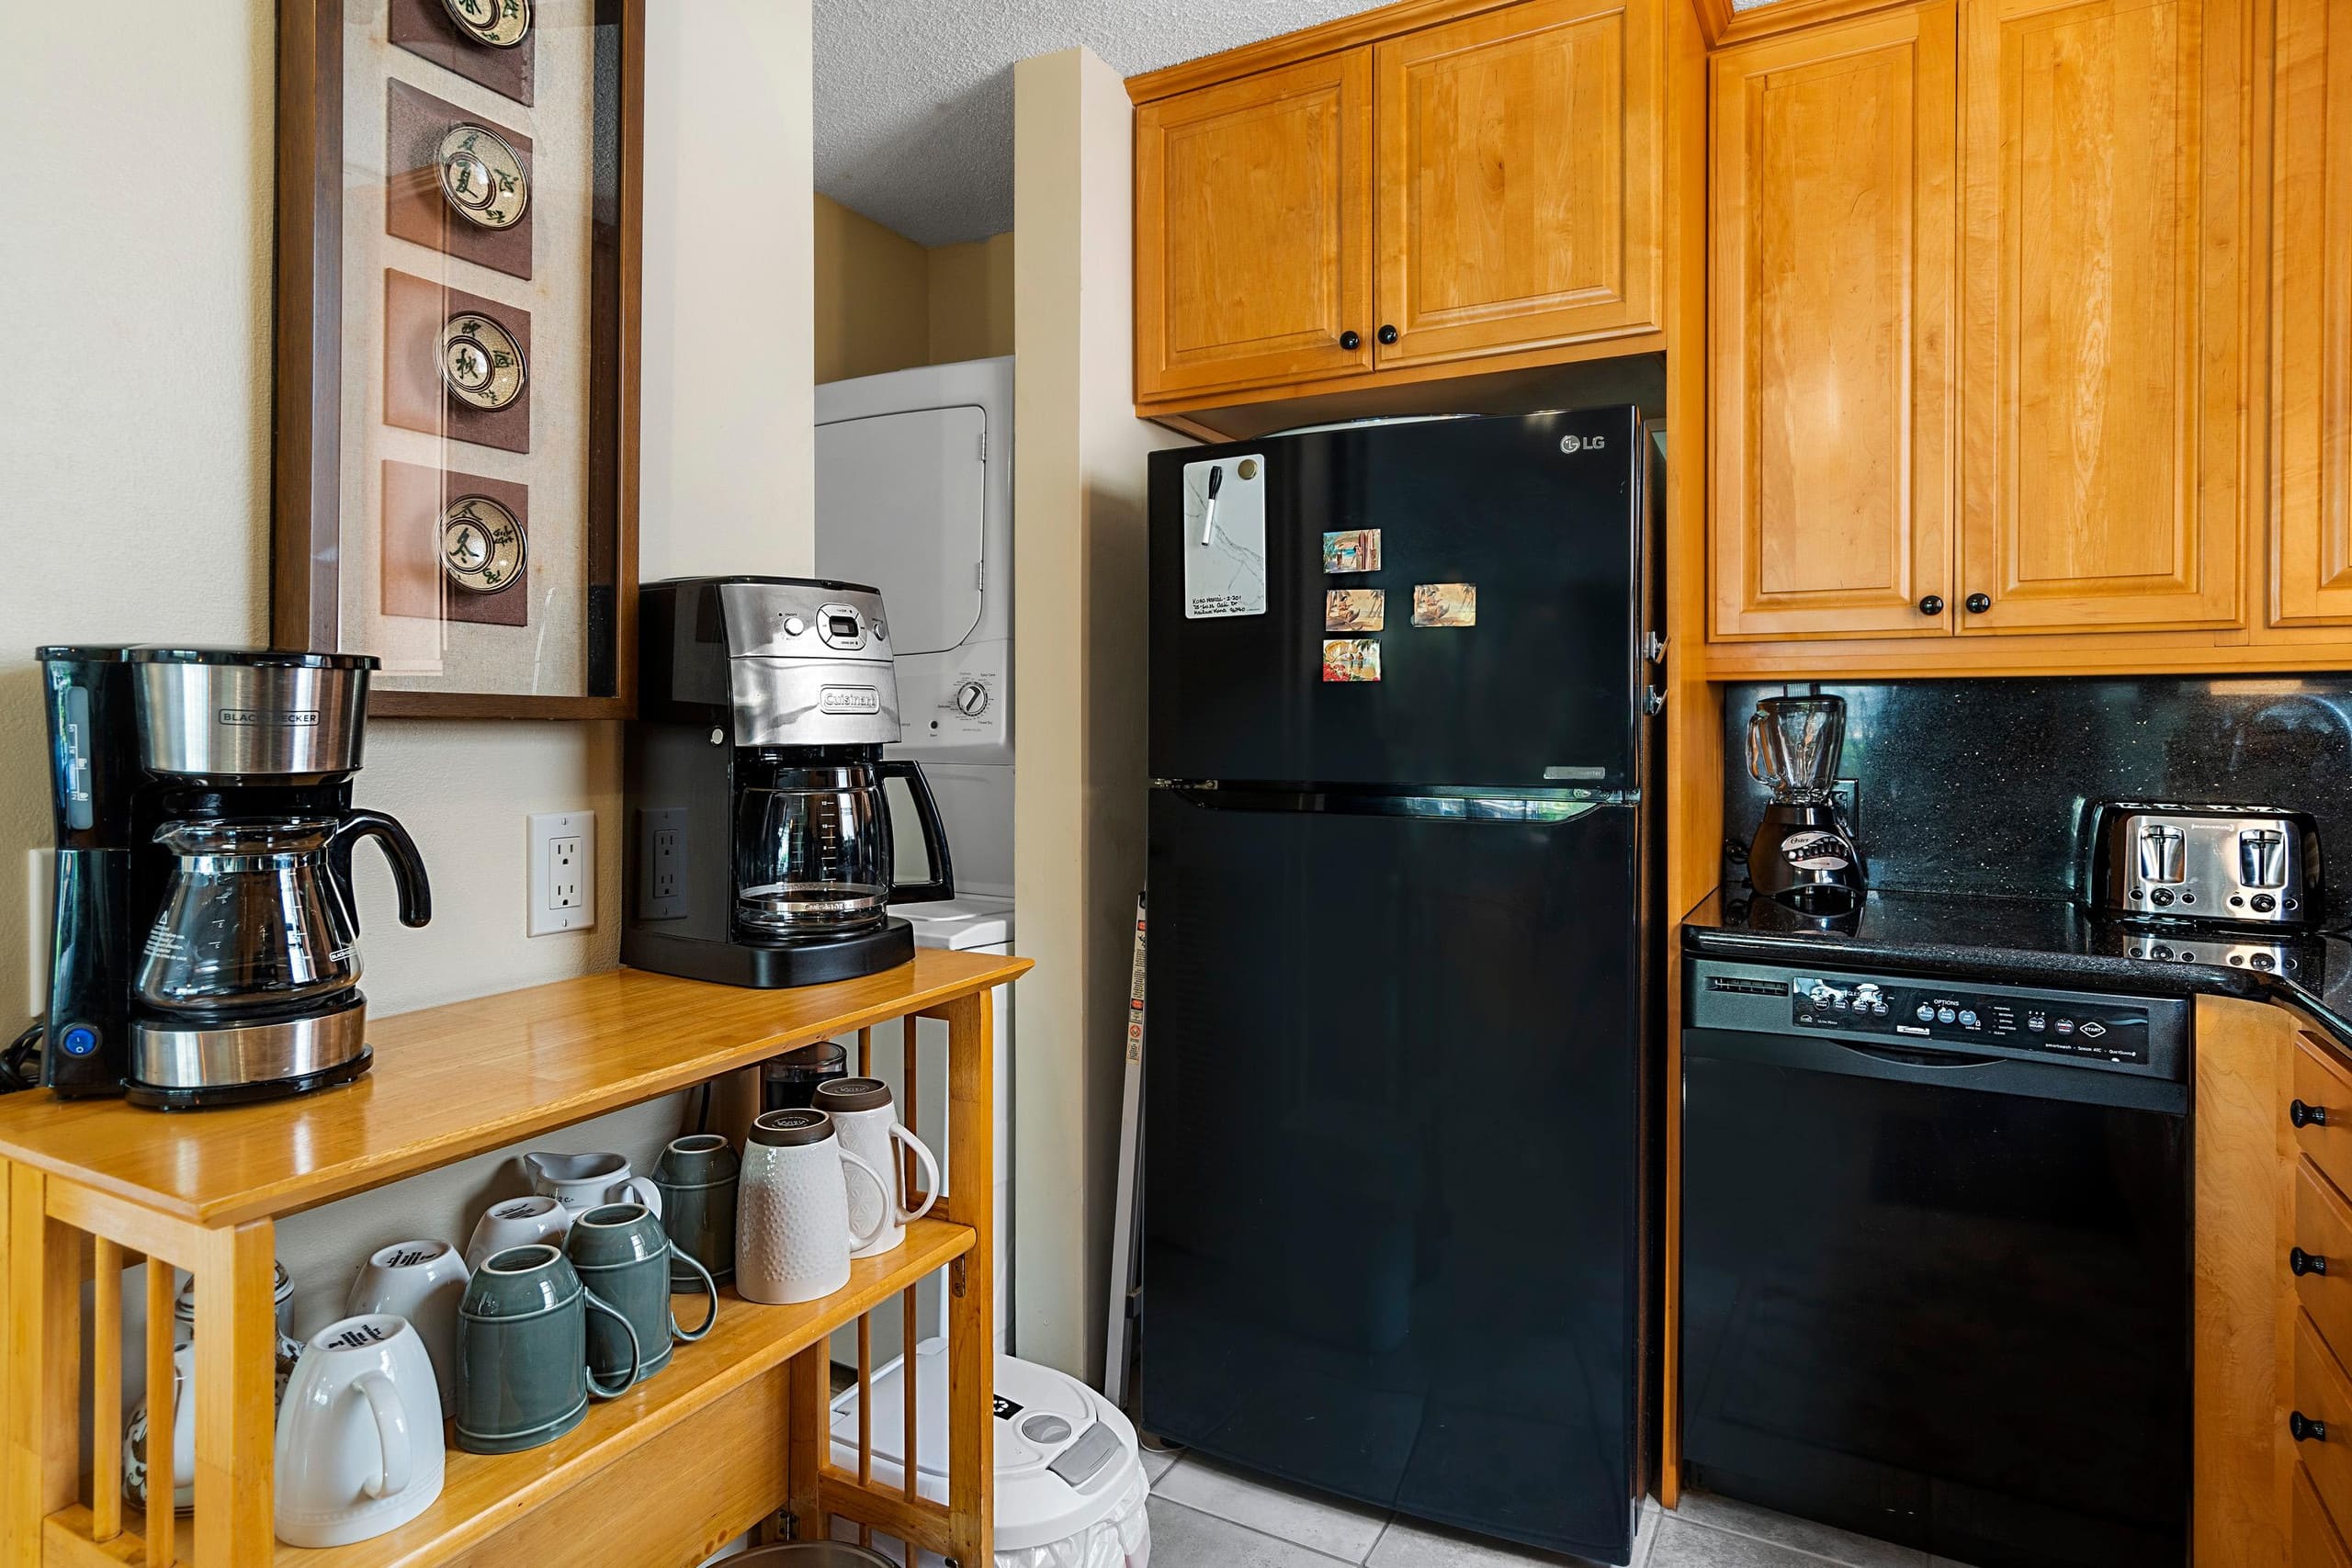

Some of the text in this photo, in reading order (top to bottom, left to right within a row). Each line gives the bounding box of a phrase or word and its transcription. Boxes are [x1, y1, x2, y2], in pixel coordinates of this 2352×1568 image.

[1583, 435, 1605, 449] LG
[825, 693, 876, 707] Cuisinart
[223, 712, 318, 723] BLACECKER
[1791, 837, 1810, 845] Oster
